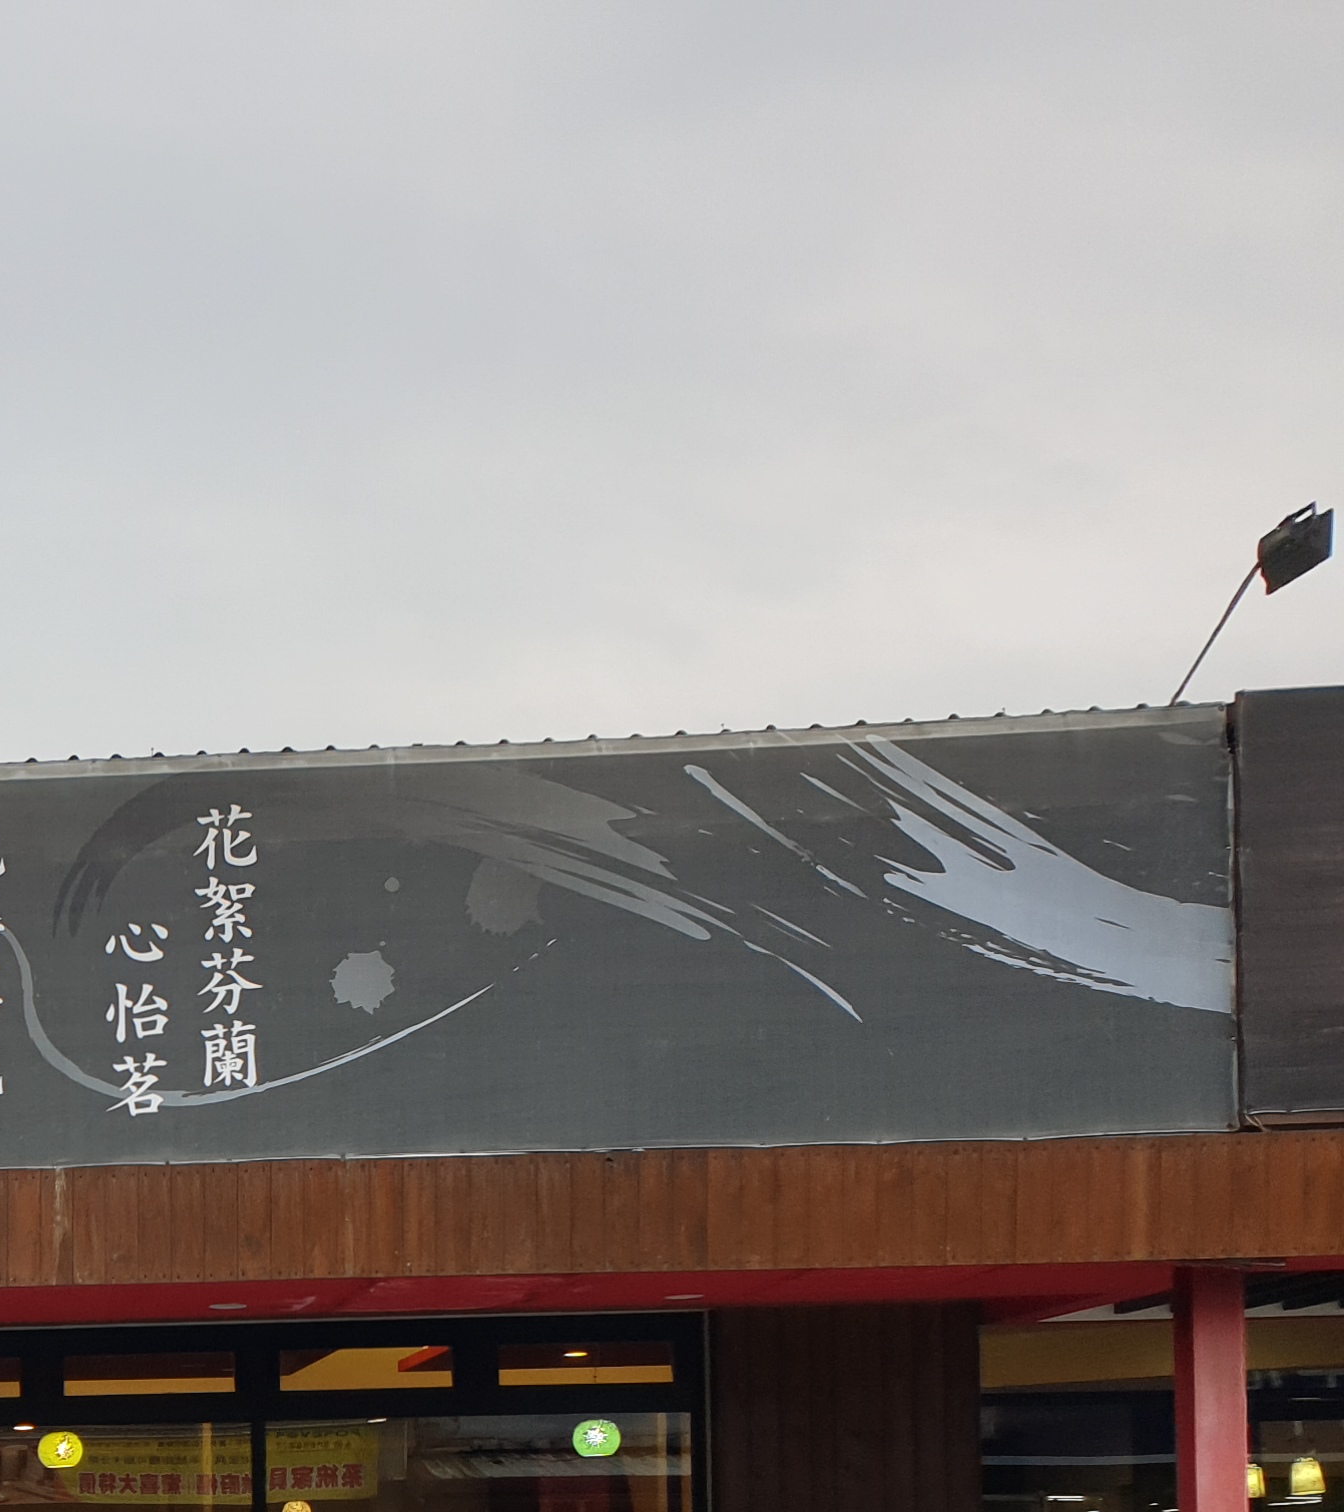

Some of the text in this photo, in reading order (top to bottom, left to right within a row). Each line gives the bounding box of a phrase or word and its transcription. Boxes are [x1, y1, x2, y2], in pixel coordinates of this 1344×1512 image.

[105, 923, 169, 1117] 心怡茗
[193, 804, 263, 1088] 花絮芬蘭
